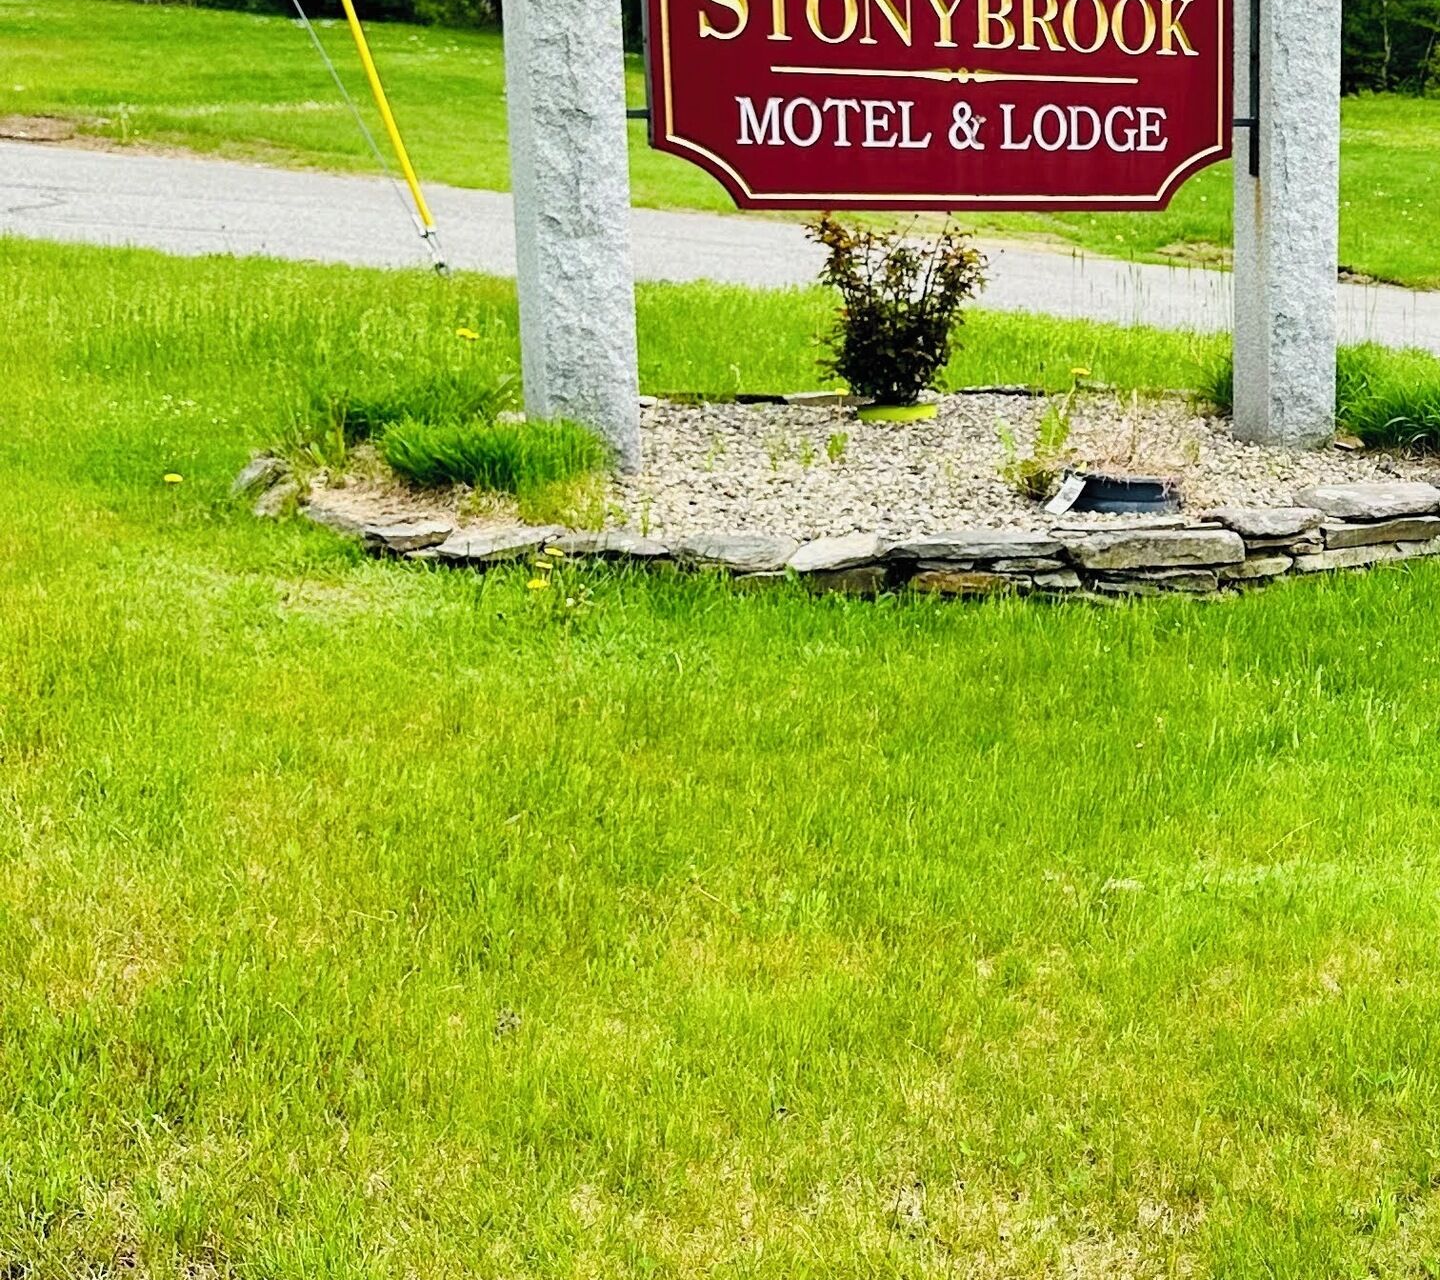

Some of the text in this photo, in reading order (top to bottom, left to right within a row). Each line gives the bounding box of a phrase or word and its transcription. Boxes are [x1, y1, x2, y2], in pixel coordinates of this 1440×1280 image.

[735, 96, 1168, 152] MOTEL & LODGE
